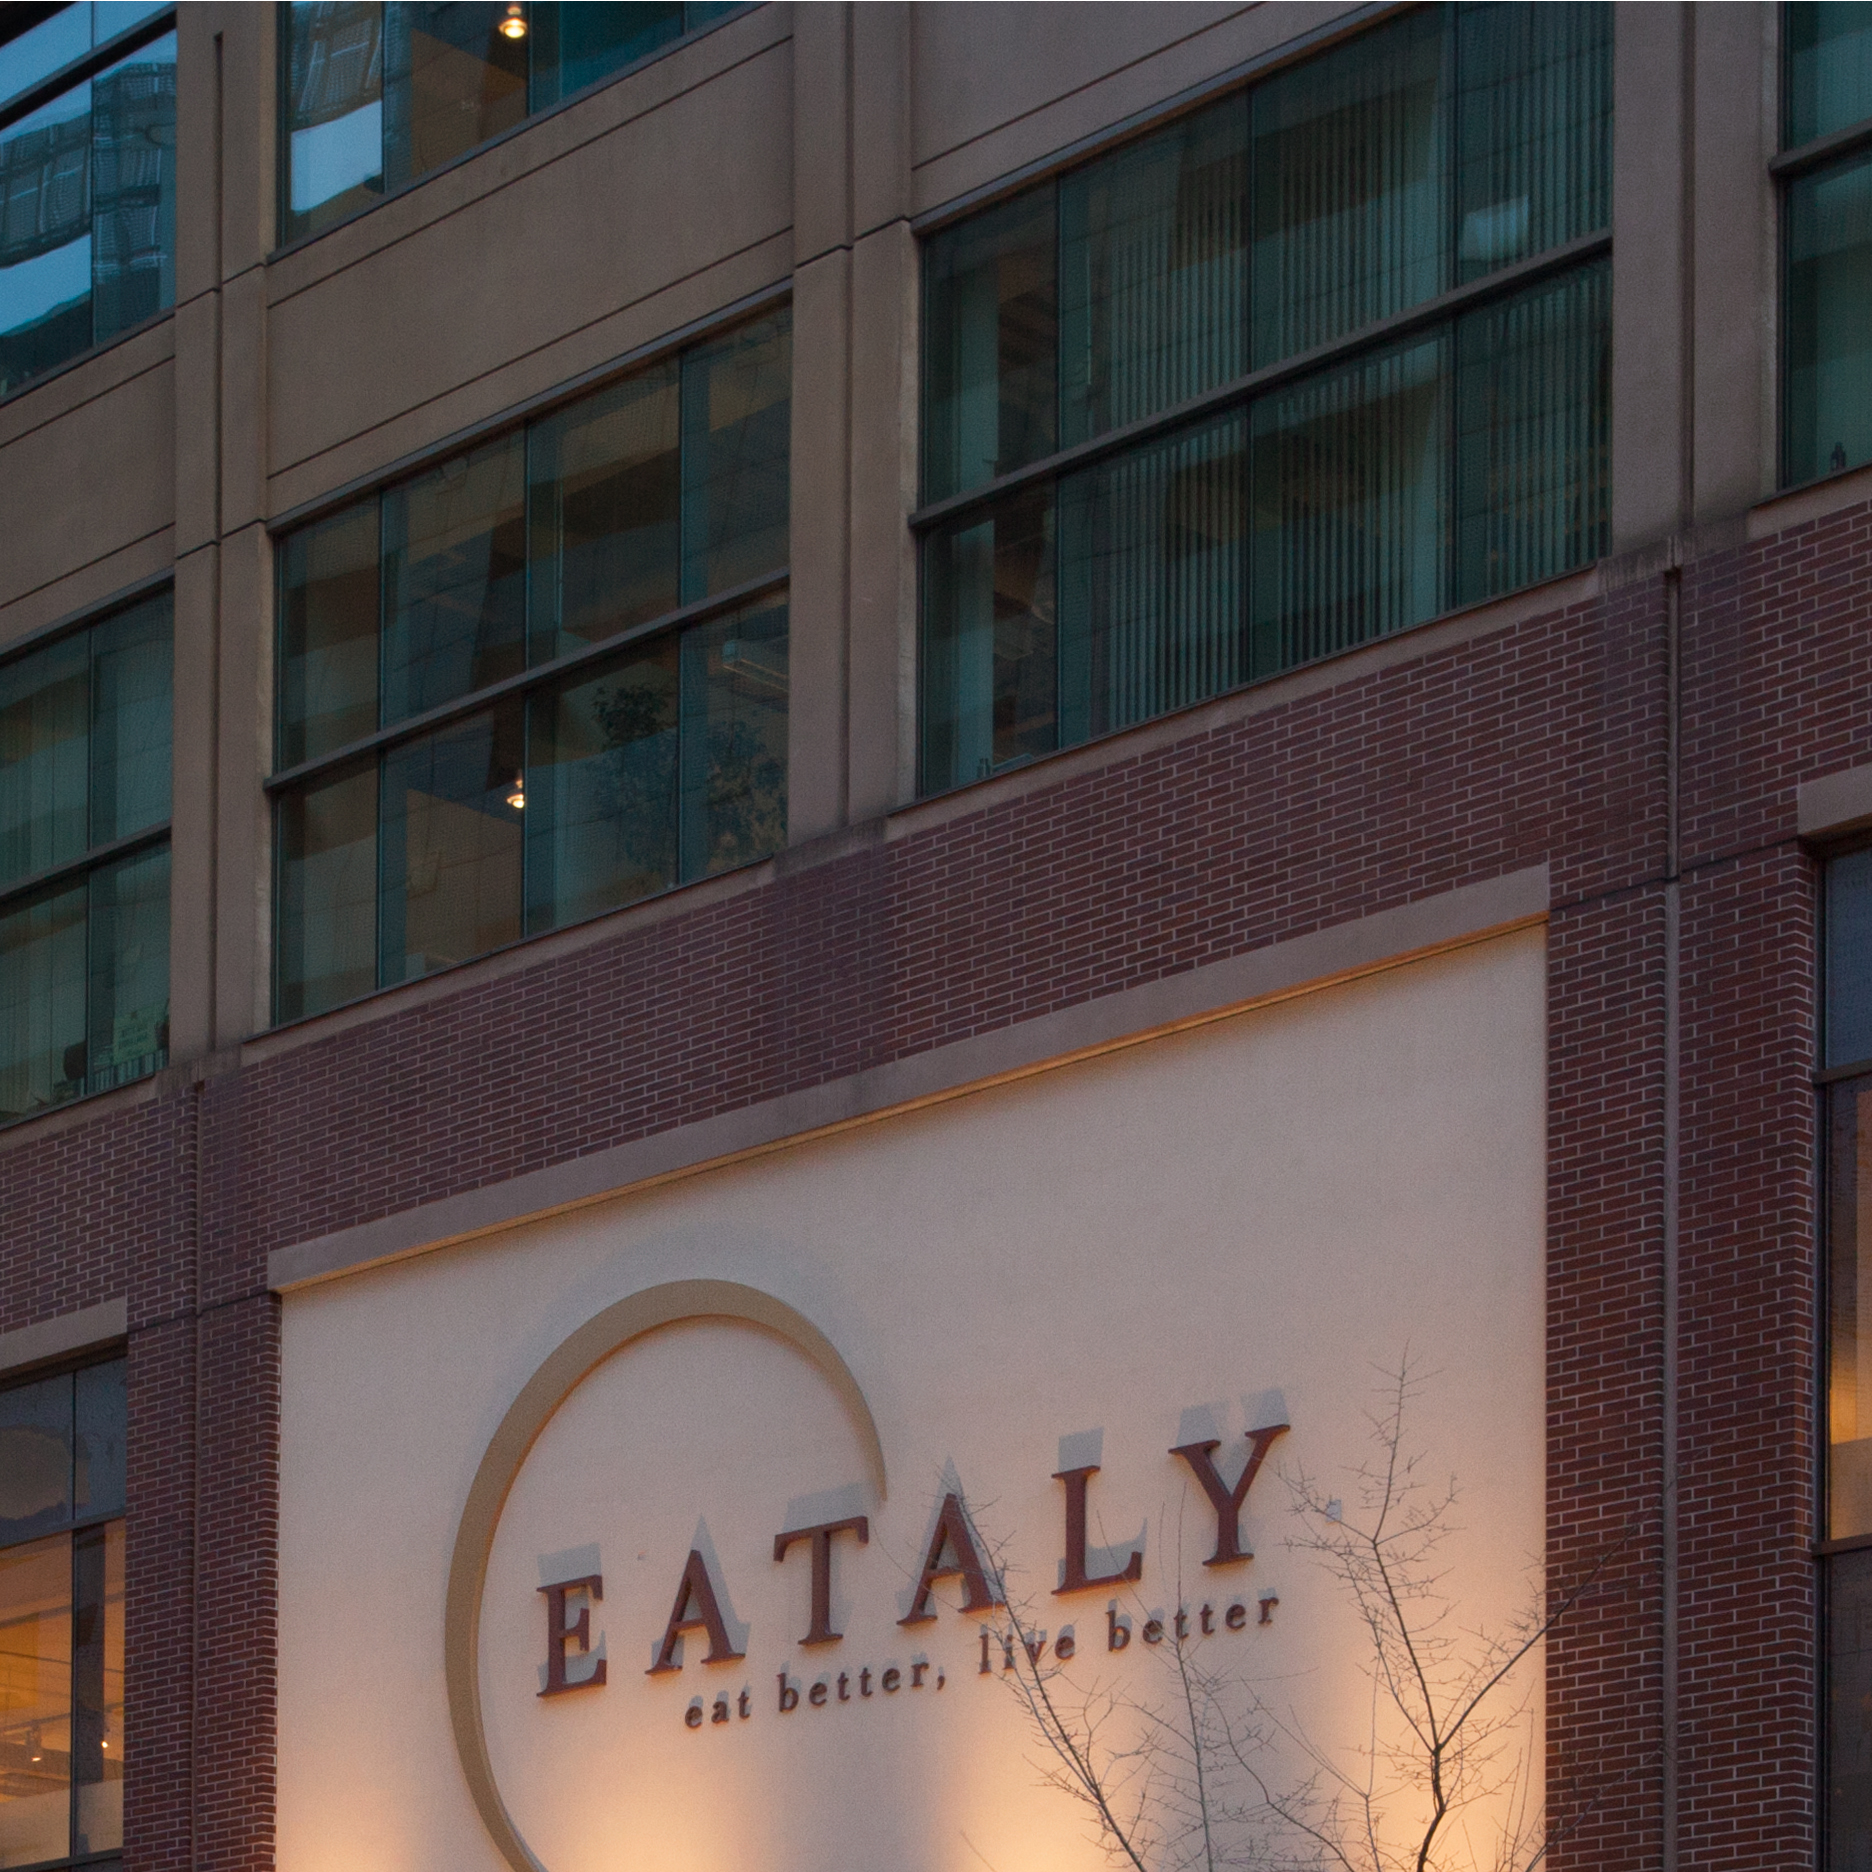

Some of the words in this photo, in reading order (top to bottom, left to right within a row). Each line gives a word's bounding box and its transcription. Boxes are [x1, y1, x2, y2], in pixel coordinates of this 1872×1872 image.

[535, 1423, 1291, 1698] EATALY
[683, 1688, 751, 1730] eat
[776, 1655, 948, 1714] better,
[978, 1626, 1076, 1676] live
[1107, 1590, 1280, 1653] better
